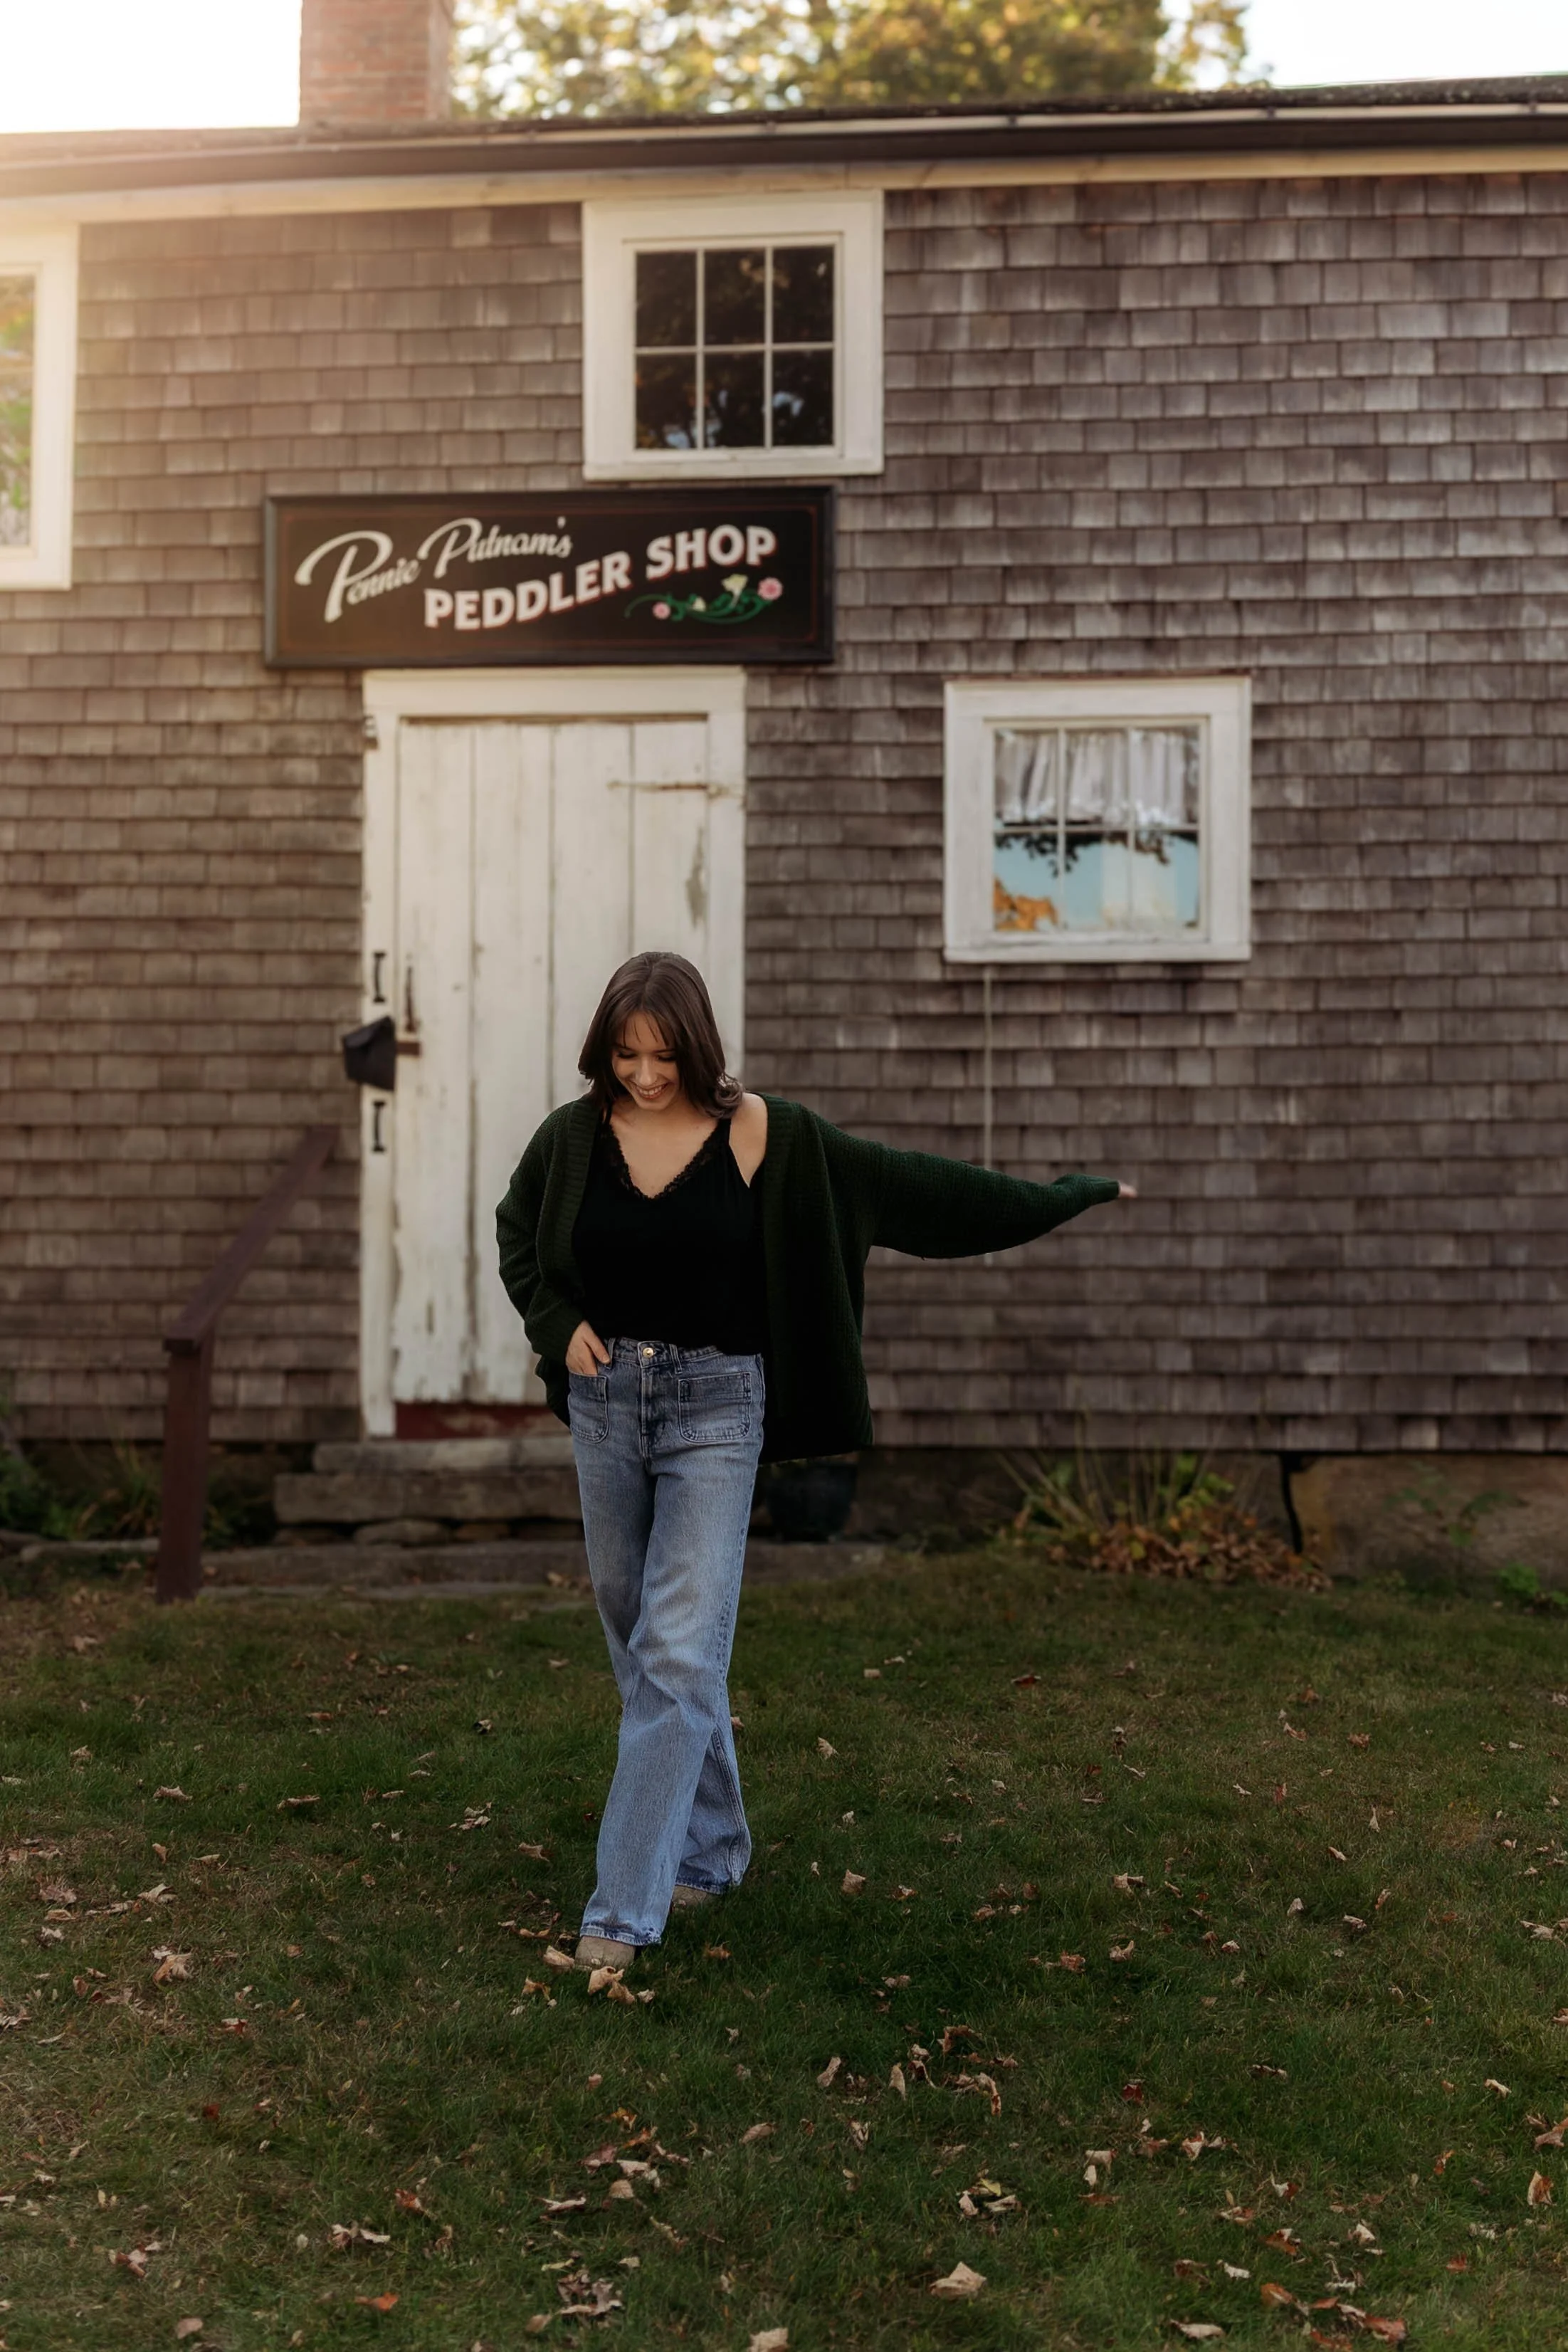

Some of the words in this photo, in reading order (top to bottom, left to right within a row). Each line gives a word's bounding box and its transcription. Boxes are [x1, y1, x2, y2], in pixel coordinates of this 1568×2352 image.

[294, 530, 421, 623] Pennie
[416, 516, 573, 579] Putnam's
[424, 550, 633, 631] PEDDLER
[646, 524, 777, 581] SHOP
